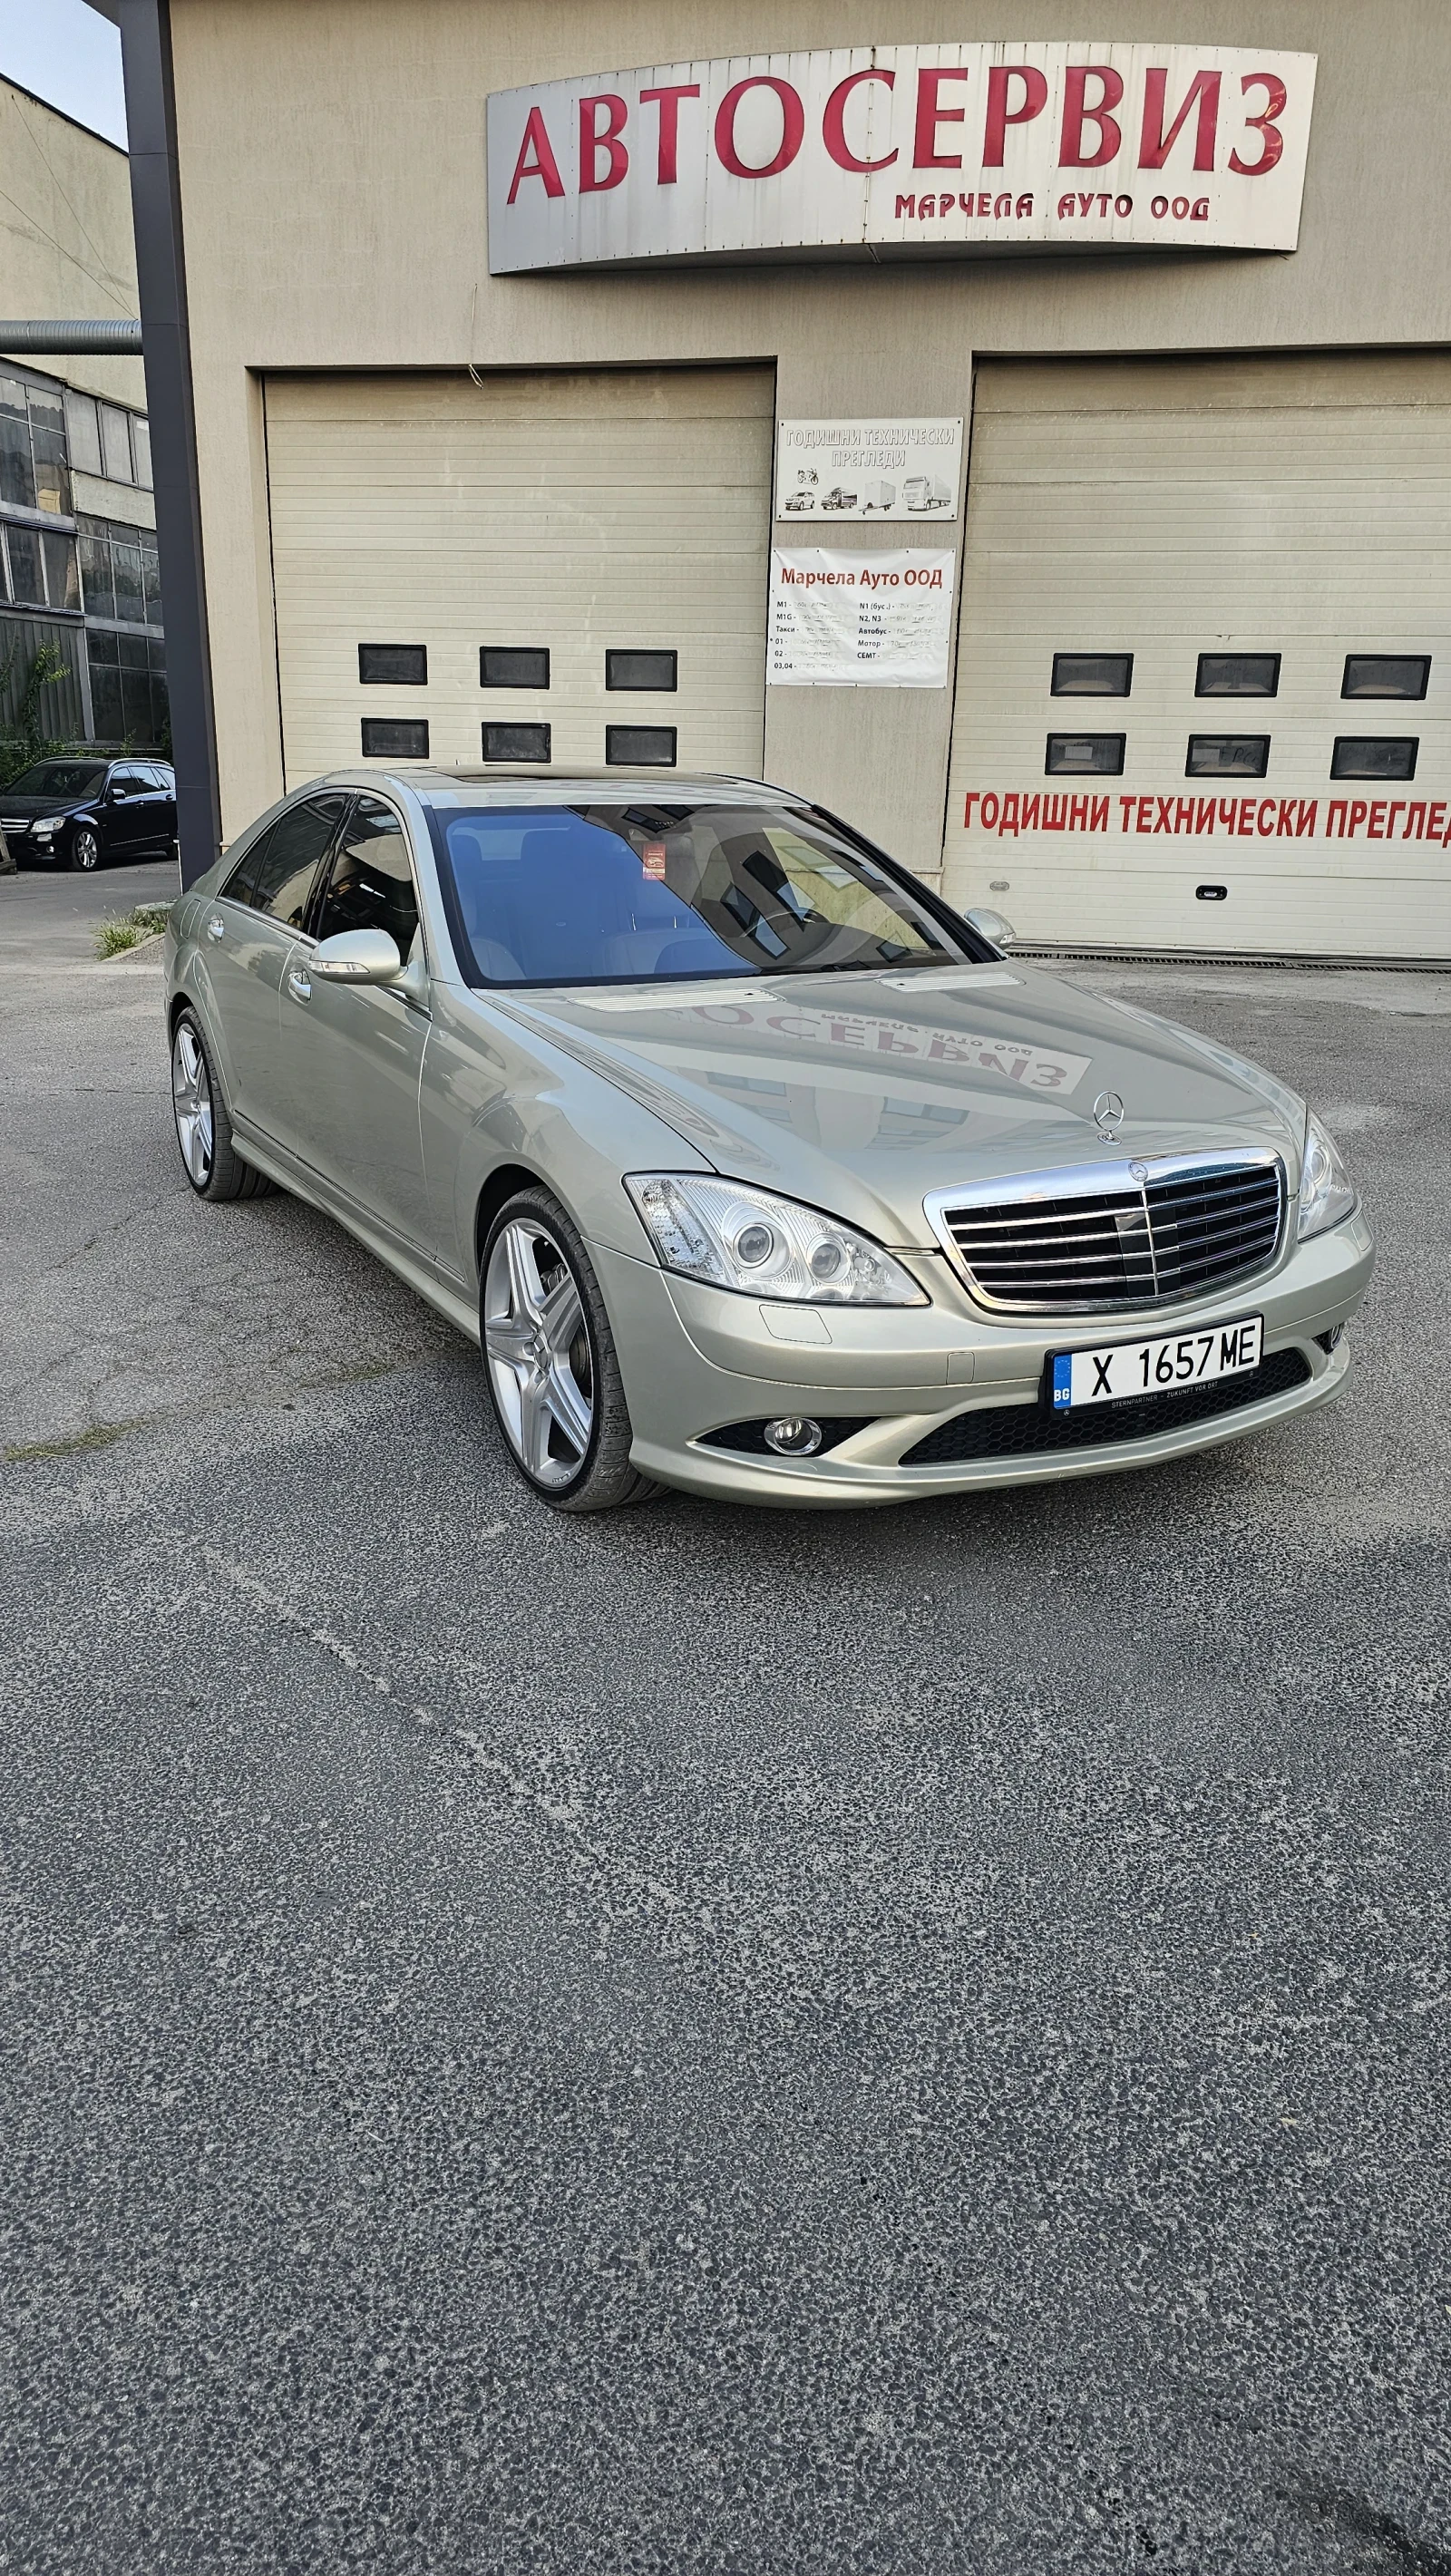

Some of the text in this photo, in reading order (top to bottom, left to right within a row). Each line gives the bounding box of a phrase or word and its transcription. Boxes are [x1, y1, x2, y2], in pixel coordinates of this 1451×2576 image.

[508, 66, 1288, 206] АВТОСЕРВИЗ
[894, 192, 1210, 222] МАРЧЕЛА АУТО ООД
[786, 428, 954, 449] ГОДИШНИ ТЕХНИЧЕСКИ
[832, 451, 906, 469] ПРЕГЛЕДИ
[781, 568, 942, 589] Марчела Ауто ООД
[858, 627, 887, 636] Автобус
[857, 639, 881, 648] Мотор
[964, 792, 1110, 837] ГОДИШНИ
[1119, 795, 1318, 837] ТЕХНИЧЕСКИ
[1091, 1325, 1256, 1396] X 1657 ME
[1054, 1387, 1070, 1403] BG
[1111, 1381, 1219, 1408] STERNPARTNER ZUKUNFT VOR ORT
